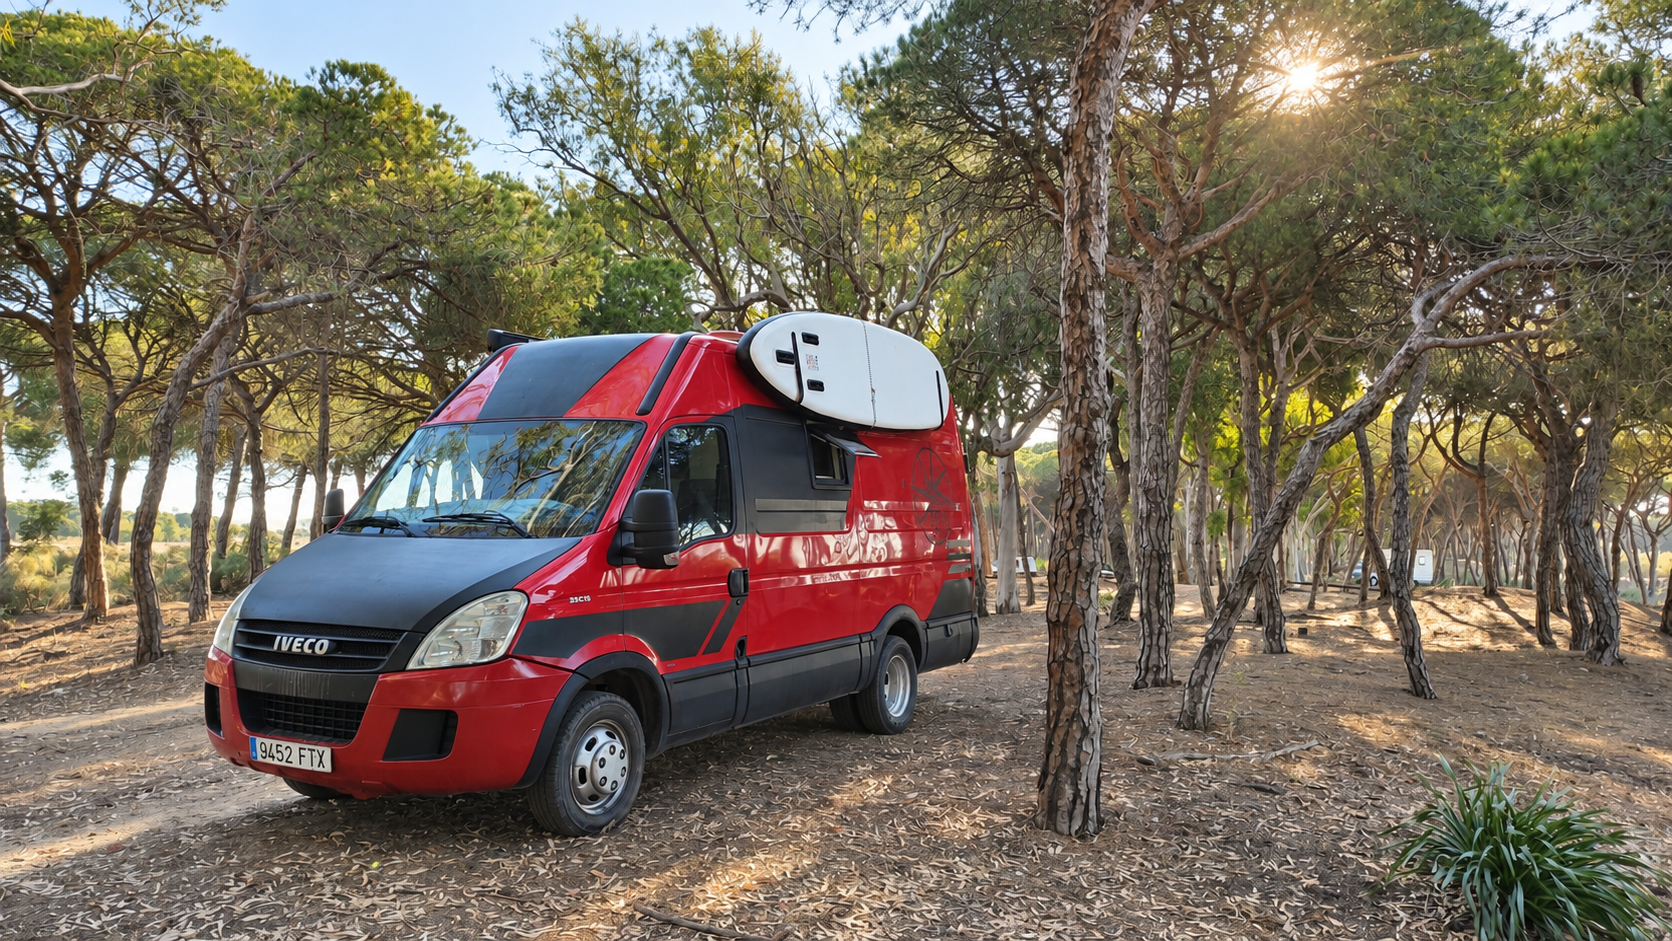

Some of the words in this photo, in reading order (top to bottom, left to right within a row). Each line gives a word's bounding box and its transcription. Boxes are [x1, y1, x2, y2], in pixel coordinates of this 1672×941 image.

[273, 635, 330, 655] IVECO
[259, 741, 293, 764] 9452
[298, 746, 325, 769] FTX
